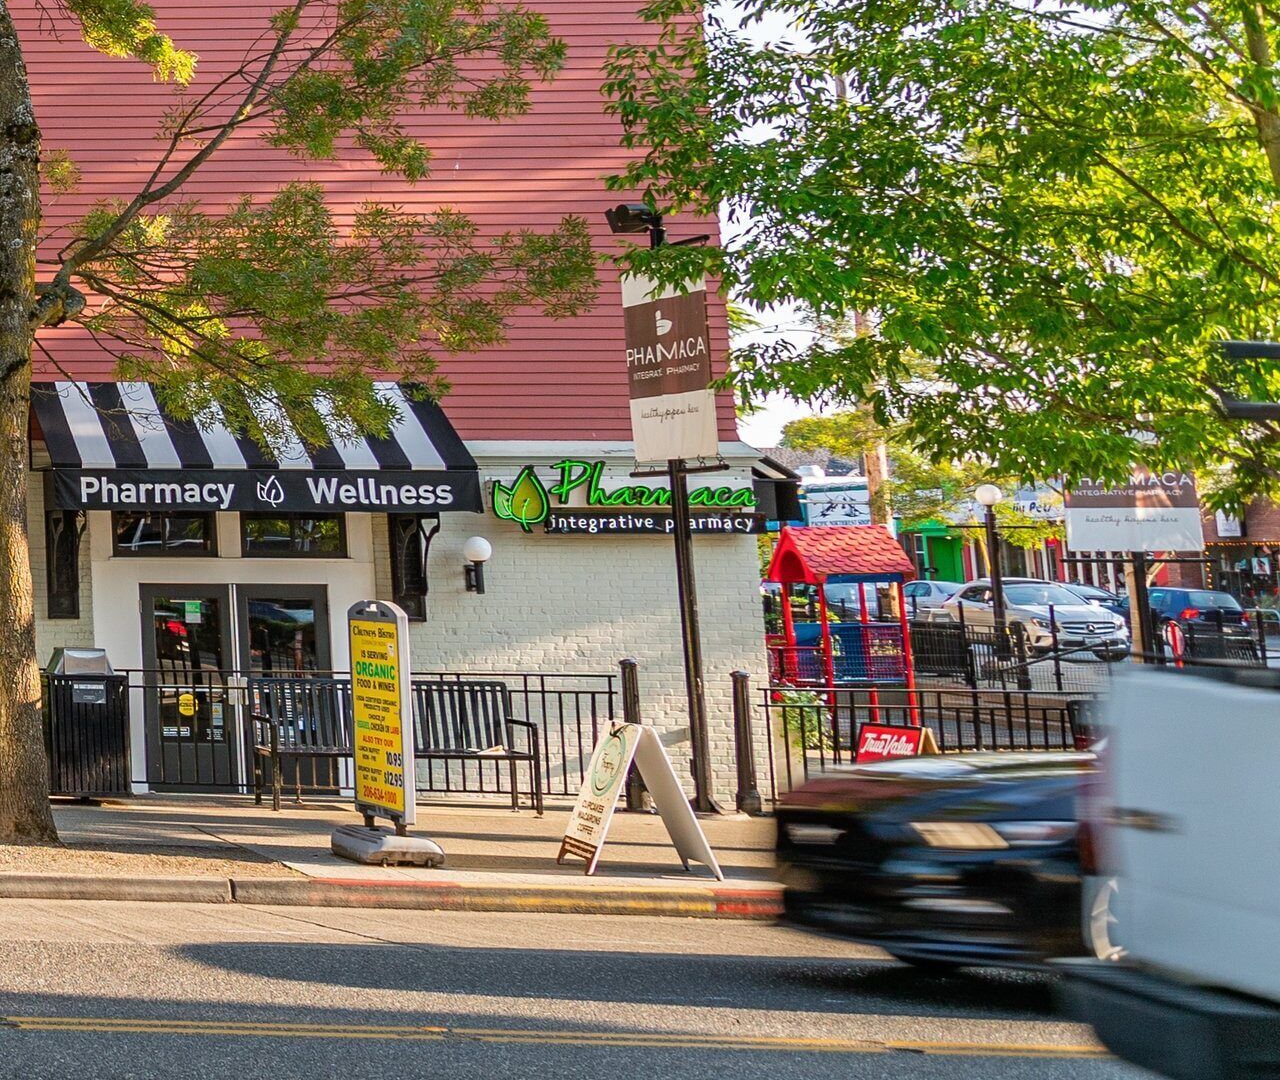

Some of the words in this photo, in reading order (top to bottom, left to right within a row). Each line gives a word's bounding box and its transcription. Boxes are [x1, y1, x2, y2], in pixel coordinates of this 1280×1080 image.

[626, 336, 706, 367] PHAMACA
[80, 477, 235, 509] Pharmacy
[306, 477, 454, 505] Wellness
[550, 516, 654, 534] integrative
[664, 516, 754, 534] parmacy
[355, 661, 395, 680] ORGANIC
[356, 678, 371, 689] FOOD
[378, 681, 395, 692] WINES
[362, 735, 373, 744] ALSO
[383, 738, 394, 748] OUR
